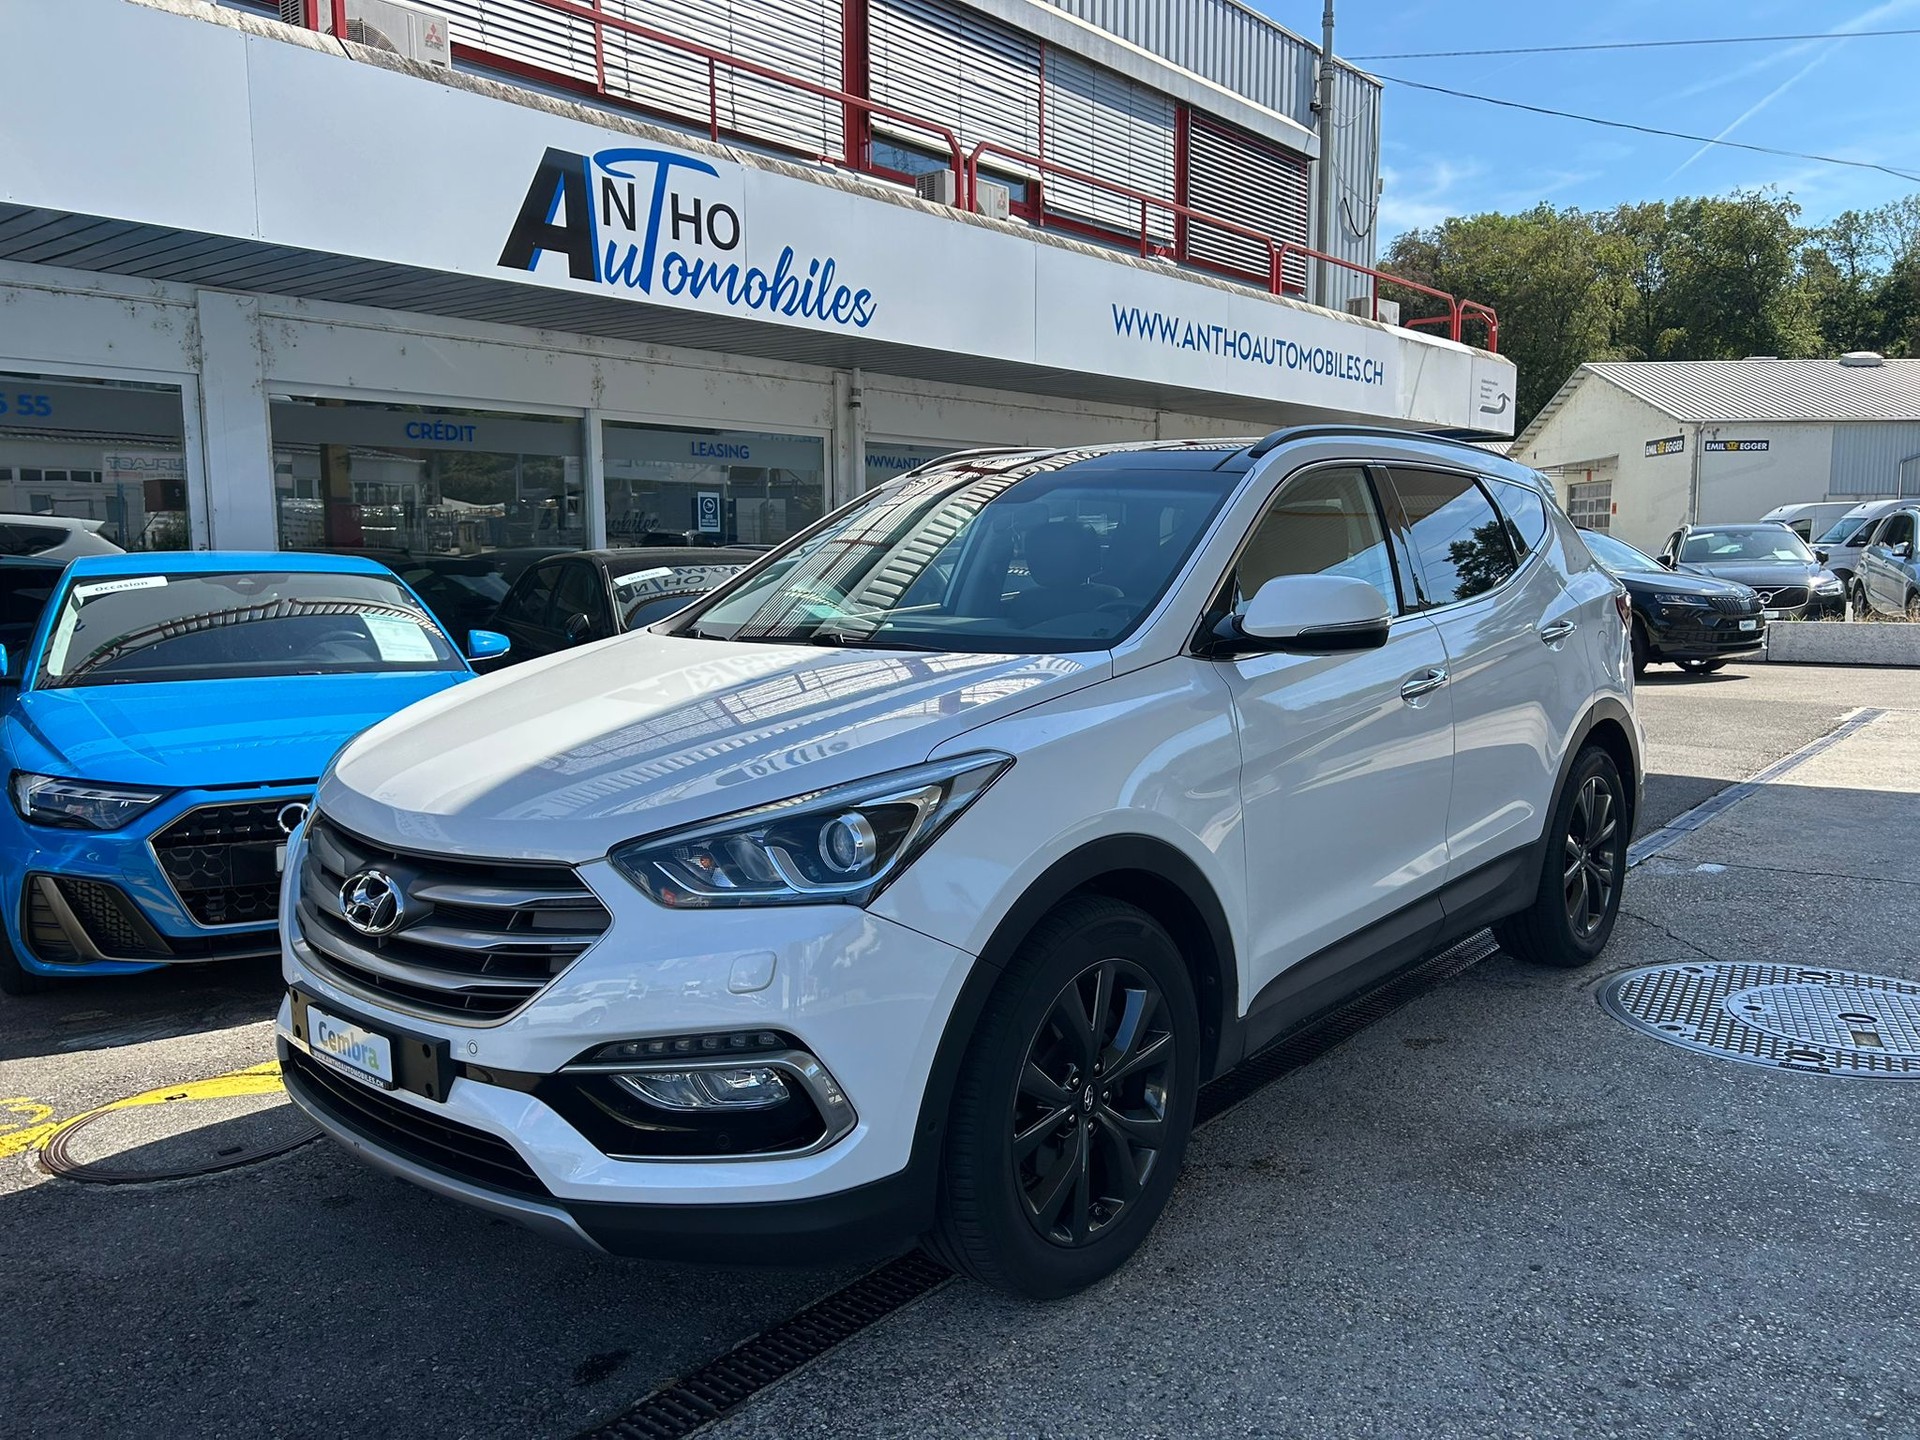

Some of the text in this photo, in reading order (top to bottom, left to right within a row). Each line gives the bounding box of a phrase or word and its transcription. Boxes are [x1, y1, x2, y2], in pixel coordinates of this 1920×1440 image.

[497, 146, 741, 294] ANTHO
[1111, 303, 1384, 386] WWW.ANTHOAUTOMOBILES.CH
[17, 394, 52, 417] 55
[406, 419, 477, 442] CRÉDIT
[691, 441, 750, 460] LEASING
[1646, 440, 1683, 456] EMIL EGGER
[1706, 442, 1768, 450] EMIL EGGER
[95, 580, 149, 592] Occasion
[318, 1020, 380, 1071] Cembra
